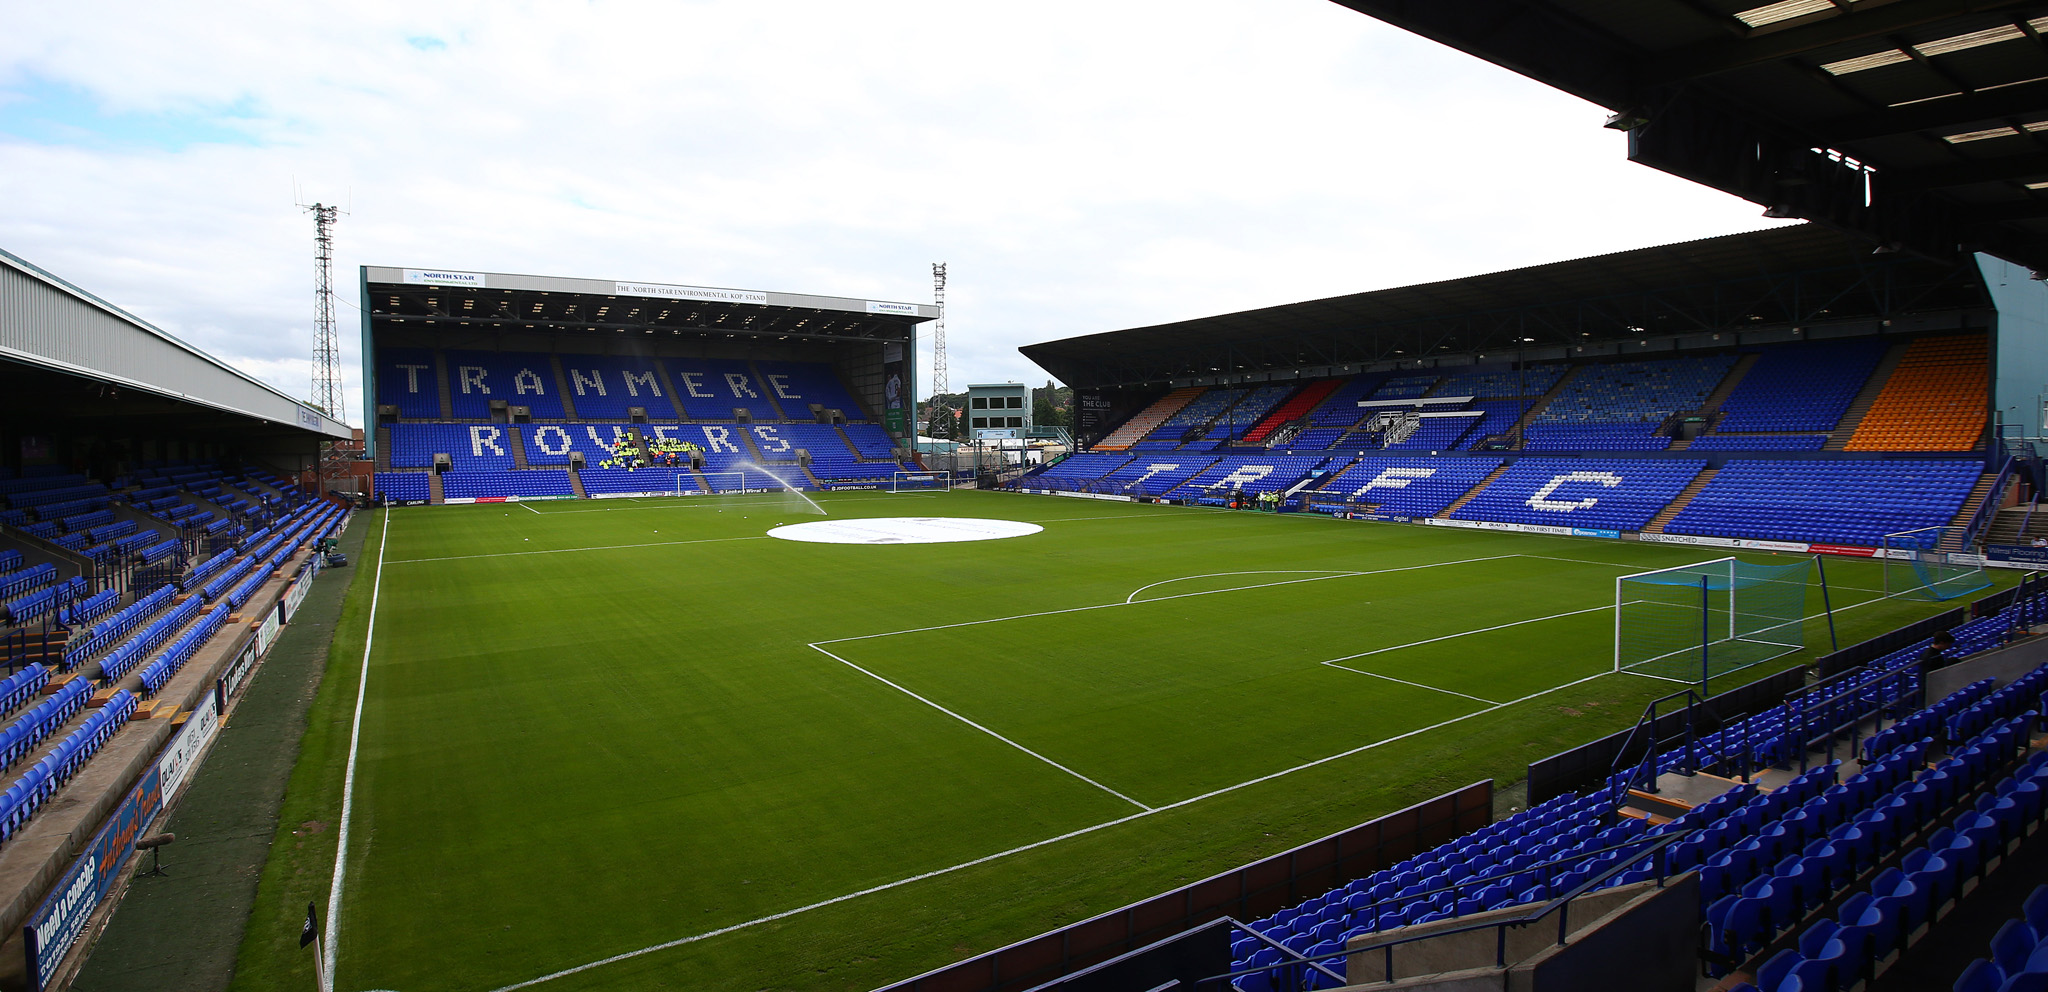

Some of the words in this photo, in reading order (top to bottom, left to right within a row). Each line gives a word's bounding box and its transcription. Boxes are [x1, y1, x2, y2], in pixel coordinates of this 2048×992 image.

[423, 272, 452, 280] NORTH
[633, 286, 656, 294] NORTH
[674, 289, 728, 299] ENVIRONMENTAL
[396, 364, 801, 399] TRANMERE
[1661, 535, 1698, 543] SNATCHED
[2012, 548, 2045, 558] Flooring
[97, 808, 139, 891] Anthony's
[36, 902, 61, 955] Need
[60, 898, 67, 921] a
[66, 855, 96, 911] coach?
